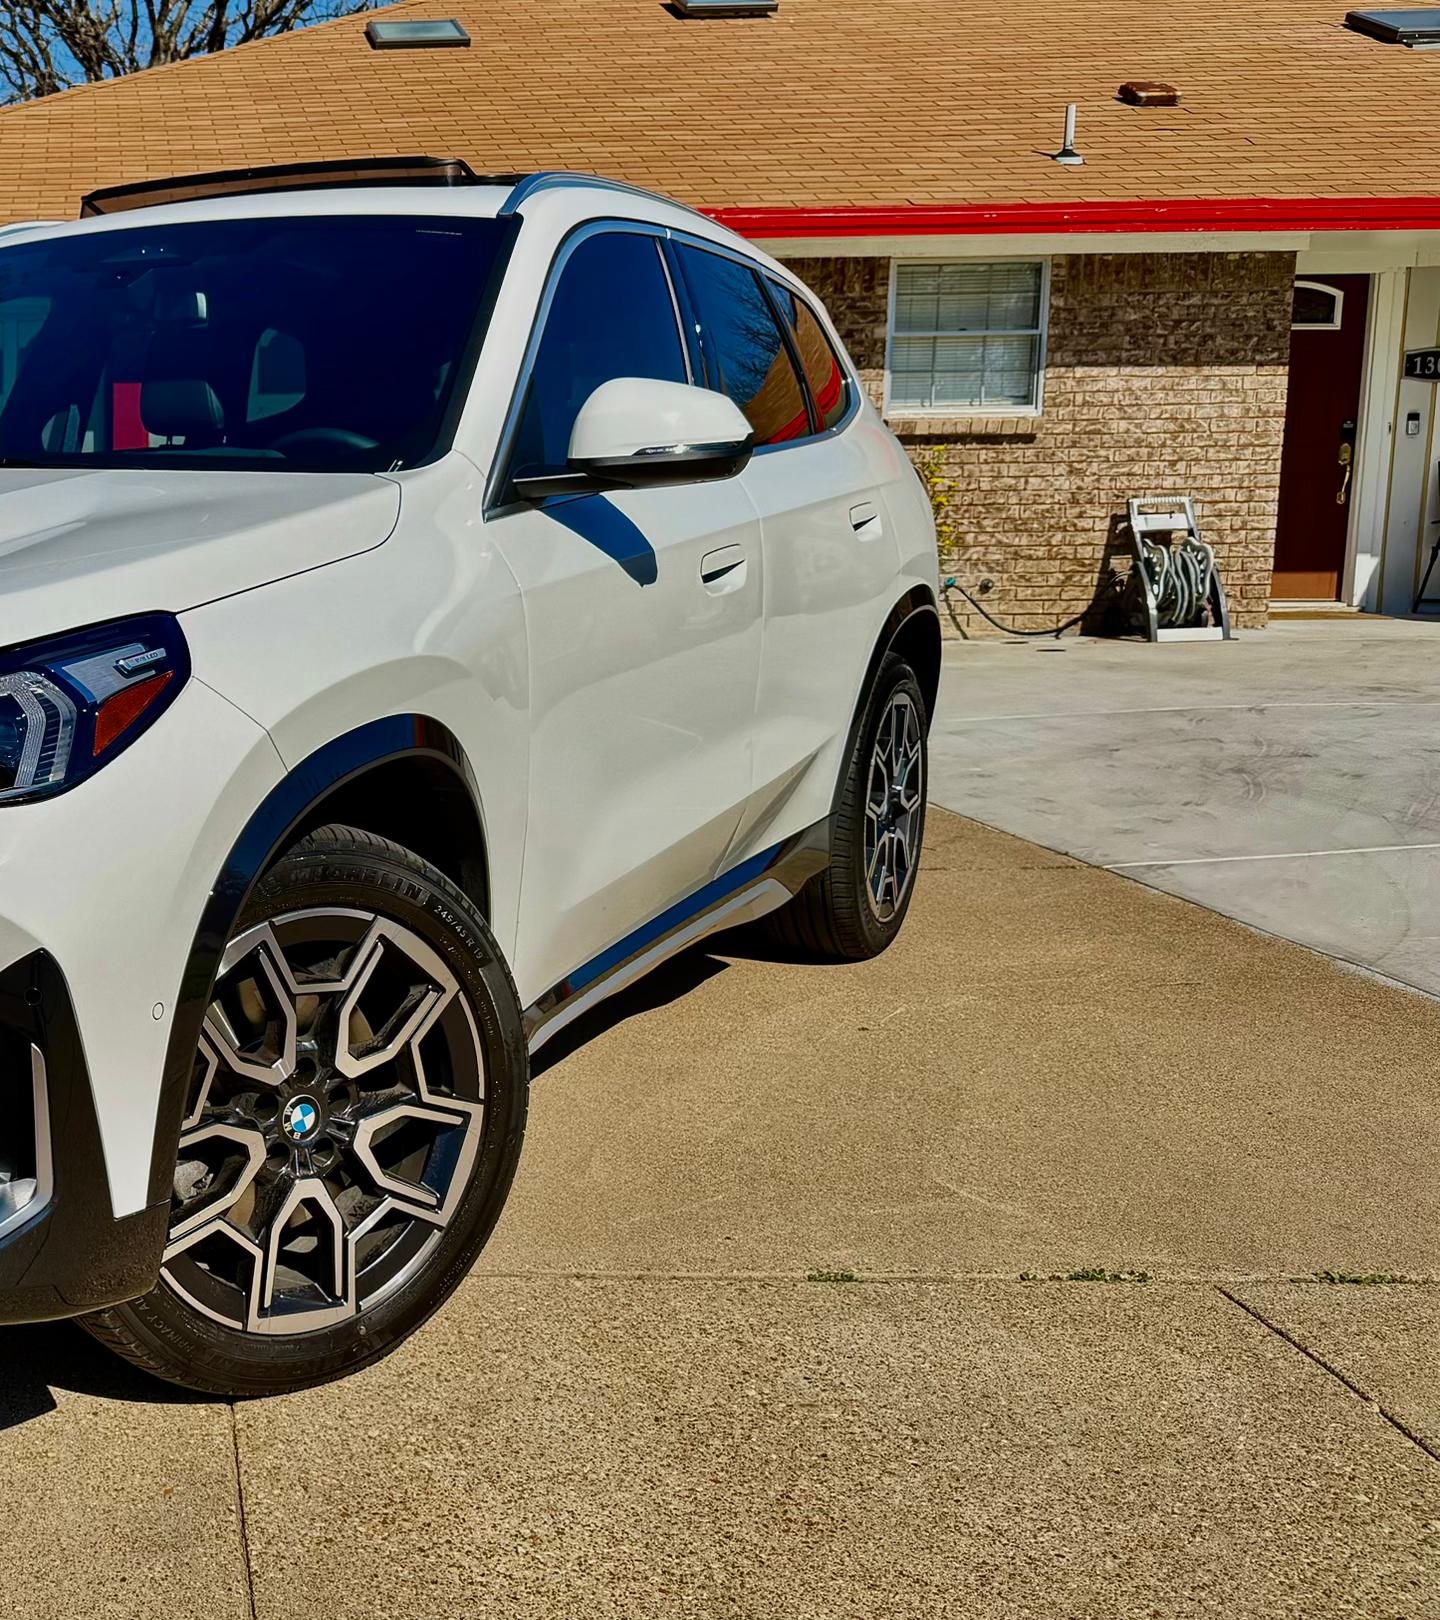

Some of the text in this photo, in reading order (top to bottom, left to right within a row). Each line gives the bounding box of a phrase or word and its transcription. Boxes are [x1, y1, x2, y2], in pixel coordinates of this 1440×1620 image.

[146, 652, 159, 660] LED
[291, 864, 423, 901] MICHELIN
[433, 905, 484, 959] 245/45 R 19
[134, 1297, 194, 1353] PRIMACY AL
